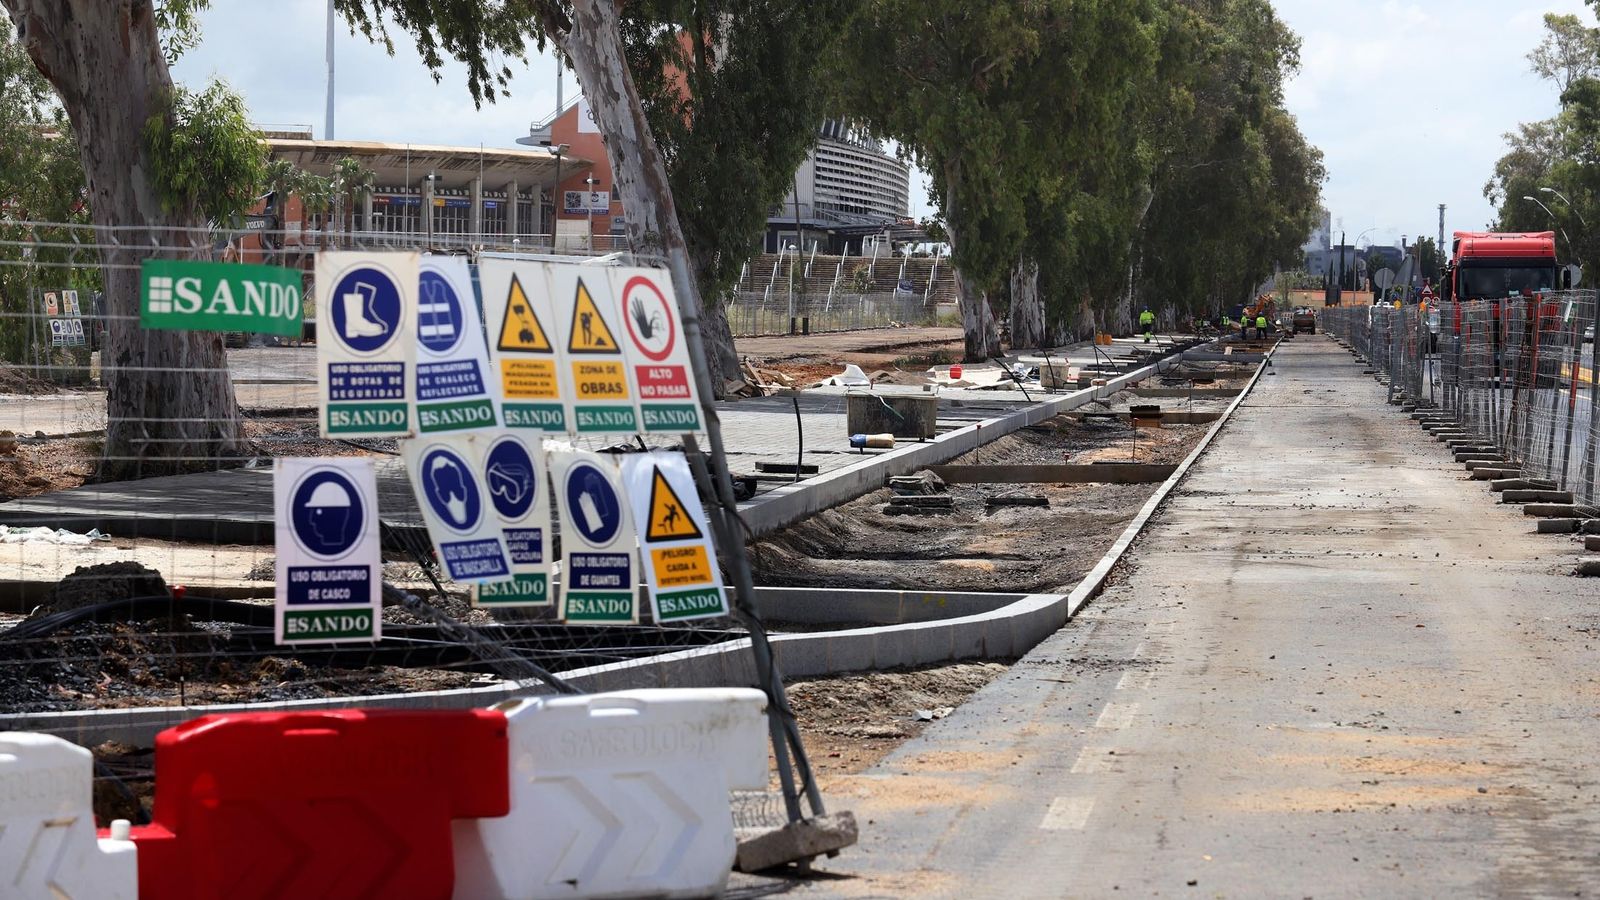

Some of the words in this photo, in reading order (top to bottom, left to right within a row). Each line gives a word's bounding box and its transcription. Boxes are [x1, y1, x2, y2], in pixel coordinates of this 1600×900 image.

[174, 276, 299, 320] SANDO
[580, 366, 603, 374] ZONA
[607, 366, 616, 374] DE
[649, 368, 672, 379] ALTO
[331, 378, 344, 386] DE
[351, 377, 382, 386] BOTAS
[389, 376, 402, 385] DE
[419, 377, 430, 386] DE
[435, 373, 477, 385] CHALECO
[332, 389, 402, 398] SEGURIDAD
[421, 384, 479, 397] REFLECTANTE
[581, 382, 623, 394] OBRAS
[641, 386, 654, 395] NO
[657, 385, 688, 396] PASAR
[340, 409, 405, 426] SANDO
[429, 406, 491, 425] SANDO
[512, 410, 562, 425] SANDO
[587, 411, 634, 425] SANDO
[650, 411, 696, 424] SANDO
[572, 557, 586, 567] USO
[587, 557, 628, 567] OBLIGATORIO
[691, 562, 697, 570] A
[291, 571, 310, 582] USO
[311, 569, 367, 581] OBLIGATORIO
[580, 575, 590, 585] DE
[591, 575, 620, 585] GUANTES
[308, 588, 320, 600] DE
[321, 588, 351, 600] CASCO
[489, 580, 544, 595] SANDO
[576, 599, 630, 614] SANDO
[667, 594, 719, 611] SANDO
[297, 615, 369, 633] SANDO
